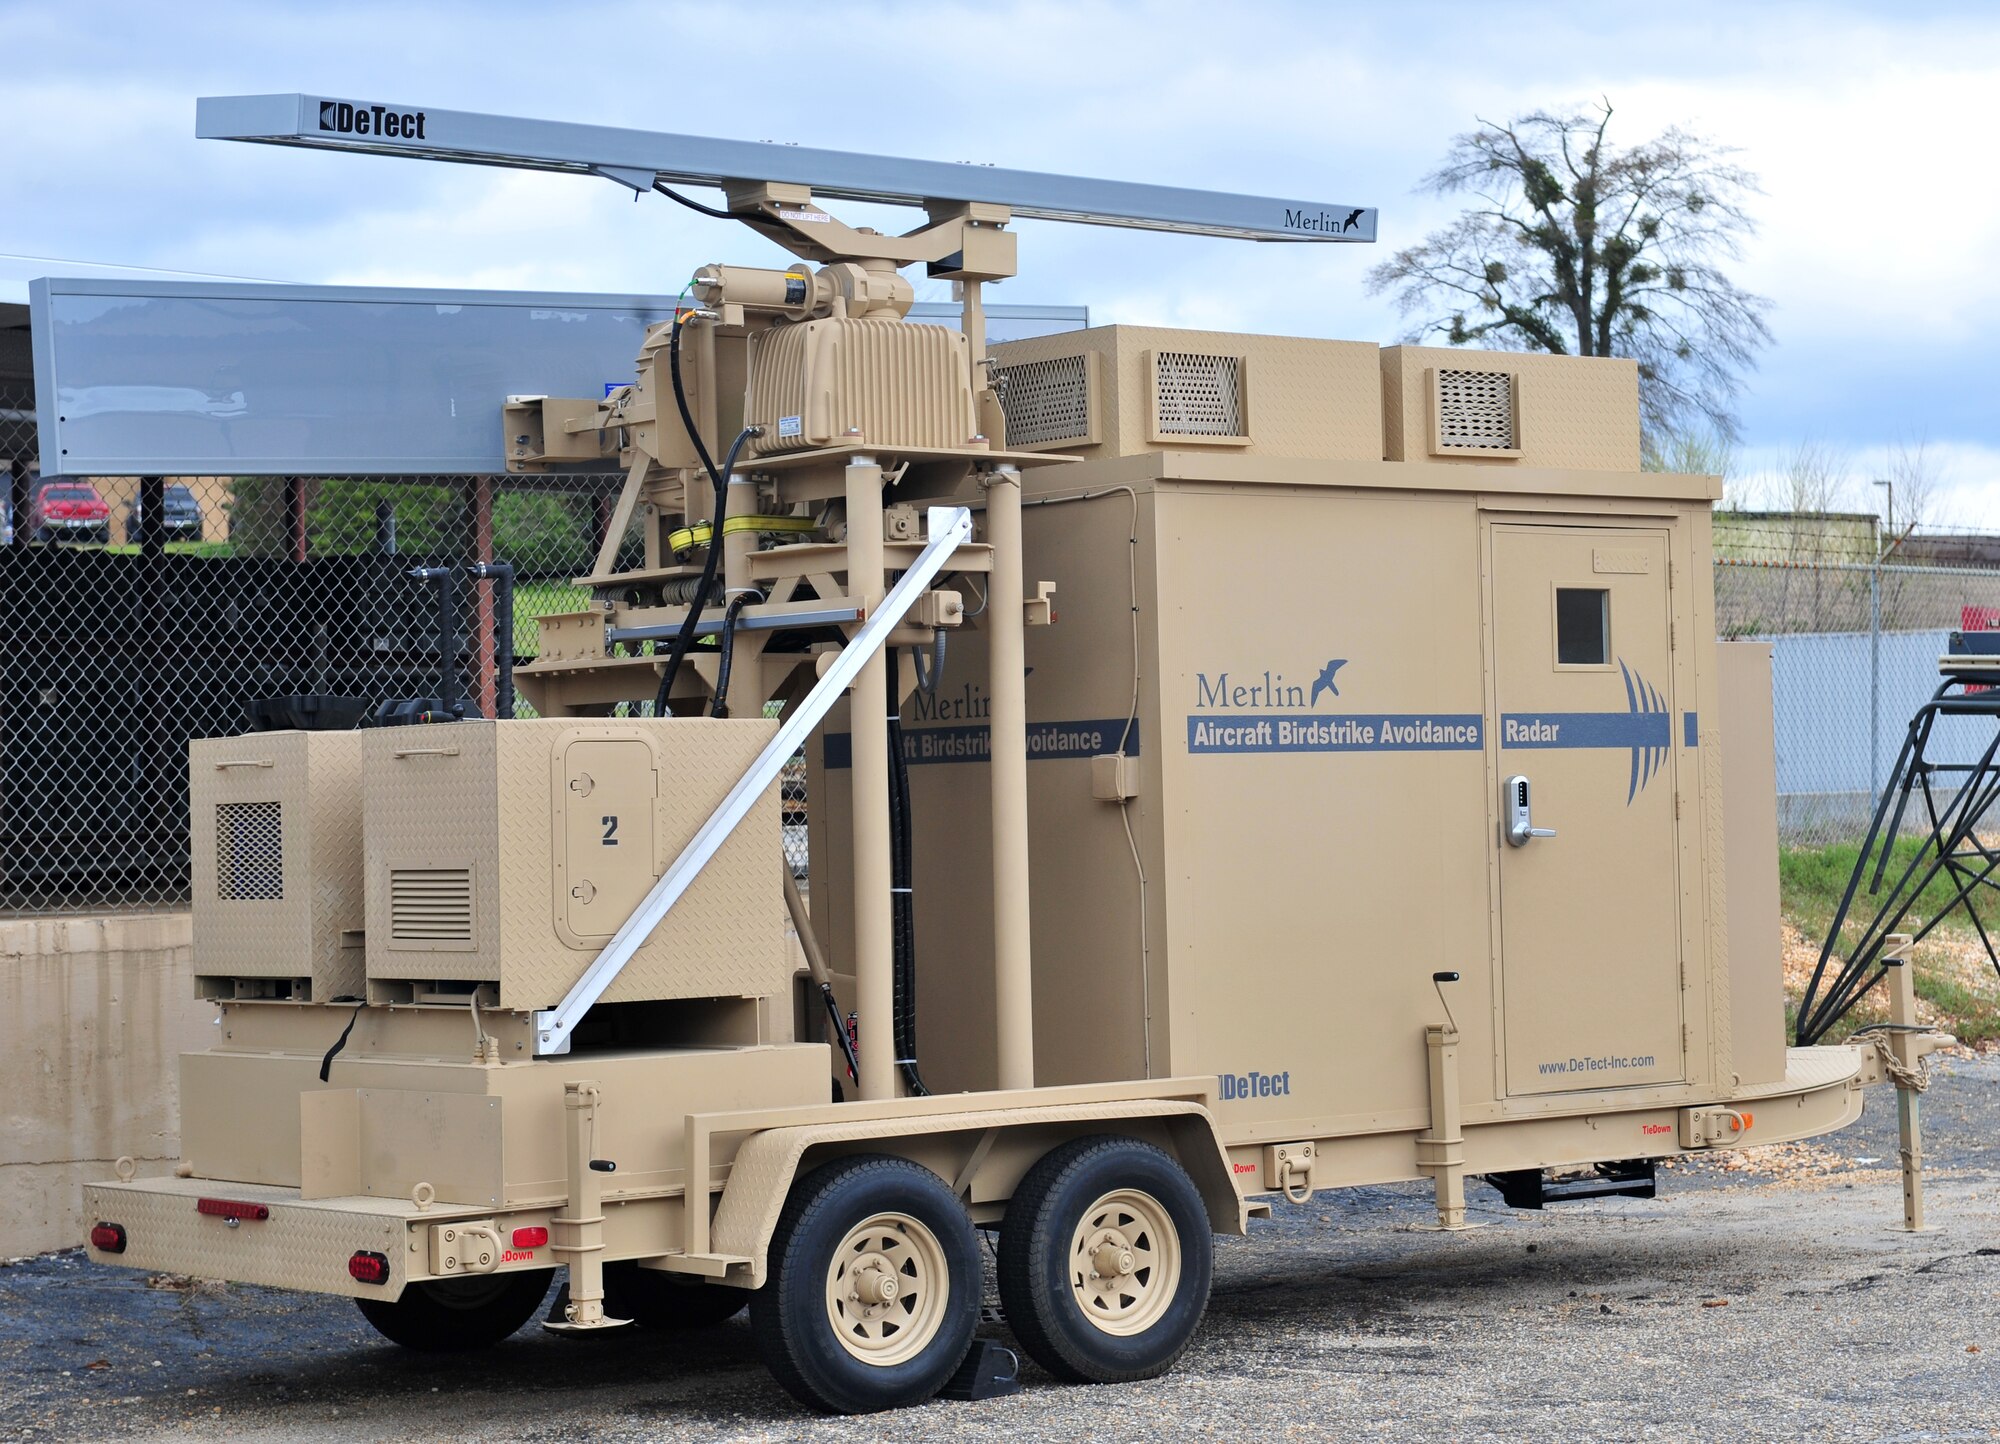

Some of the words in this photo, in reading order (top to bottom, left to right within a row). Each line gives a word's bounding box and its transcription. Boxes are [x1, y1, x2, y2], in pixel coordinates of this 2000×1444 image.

[337, 102, 426, 140] DeTect
[1284, 208, 1341, 233] Merlin
[1195, 671, 1306, 708] Merlin
[921, 730, 991, 757] Birdstrik
[1025, 727, 1102, 752] voidance
[1194, 721, 1272, 746] Aircraft
[1278, 720, 1375, 745] Birdstrike
[1379, 720, 1478, 744] Avoidance
[1505, 719, 1560, 743] Radar
[602, 816, 618, 845] 2
[1539, 1055, 1655, 1075] www.DeTect-Inc.com
[1223, 1071, 1290, 1100] DeTect
[1642, 1124, 1671, 1135] TieDown
[1233, 1163, 1256, 1174] Down
[501, 1250, 533, 1262] eDown
